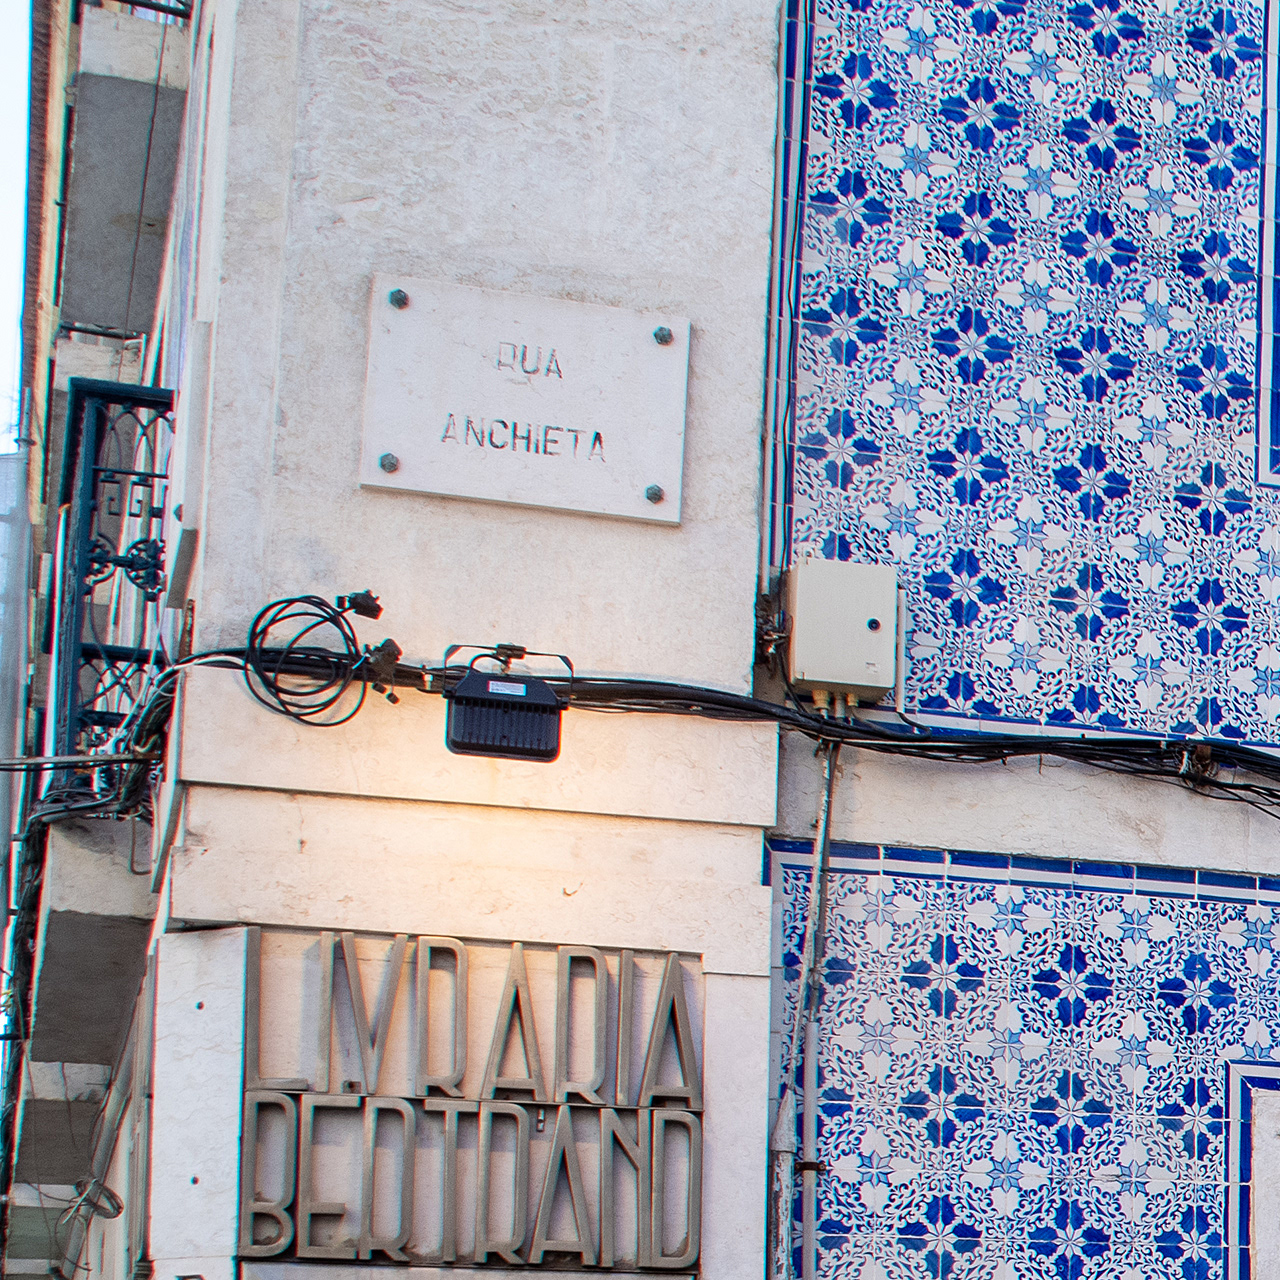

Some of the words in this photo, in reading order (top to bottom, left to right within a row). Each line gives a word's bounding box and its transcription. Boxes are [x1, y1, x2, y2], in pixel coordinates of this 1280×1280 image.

[496, 341, 563, 379] RUA
[441, 412, 606, 463] ANCHIETA
[245, 926, 701, 1108] LIVRARIA
[238, 1091, 702, 1269] BERTRAND
